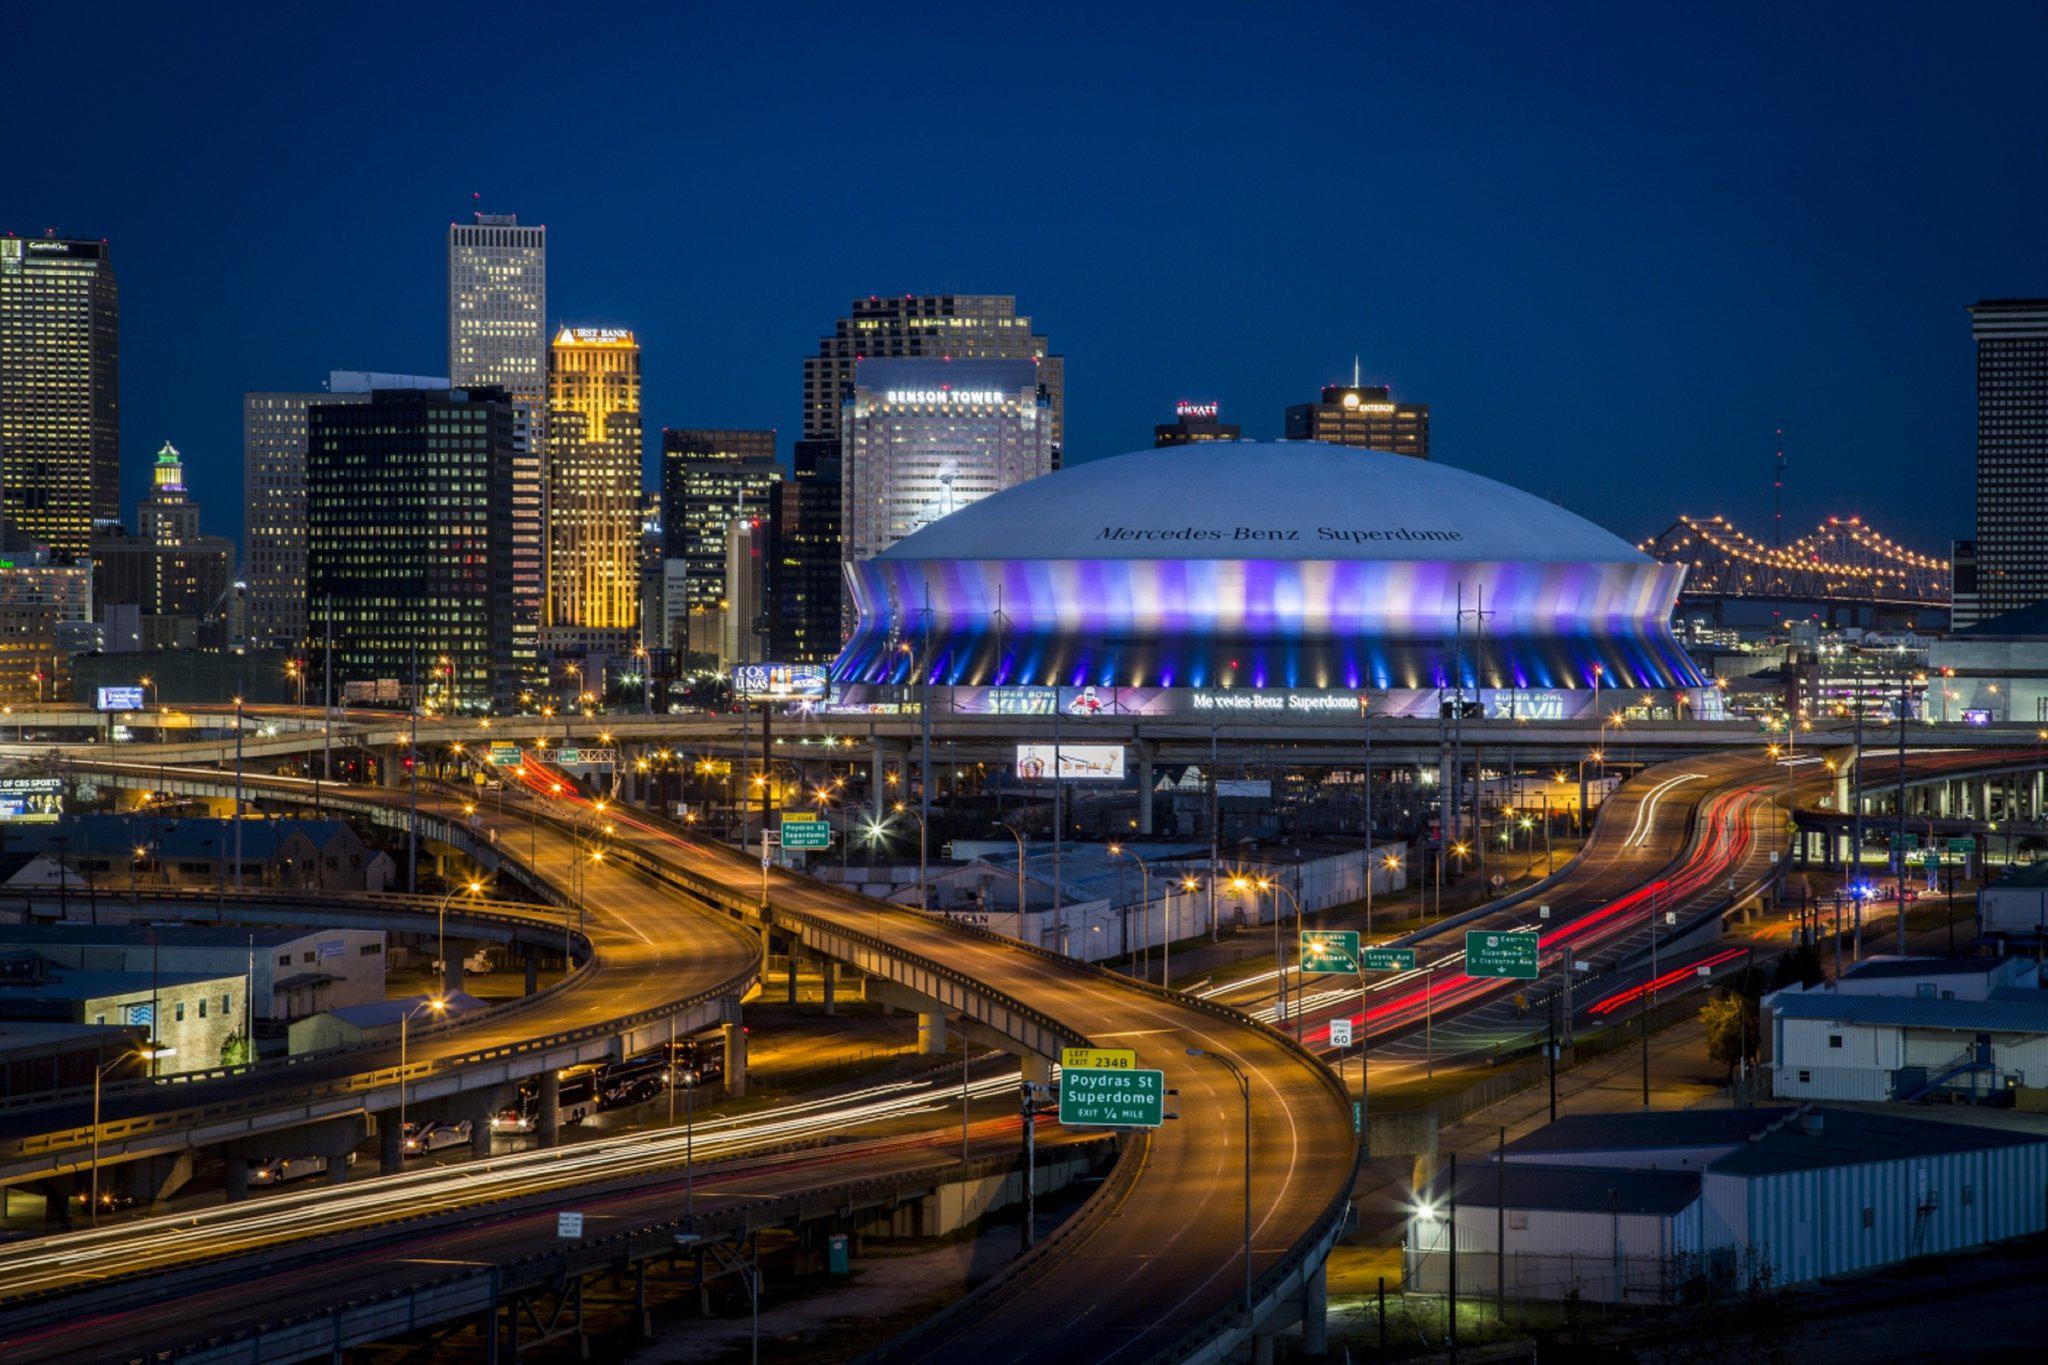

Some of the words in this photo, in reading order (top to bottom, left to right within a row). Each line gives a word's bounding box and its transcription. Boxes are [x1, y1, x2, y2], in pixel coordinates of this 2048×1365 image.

[600, 329, 628, 338] BANK
[887, 391, 948, 404] BENSON
[950, 391, 1004, 404] TOWER
[1096, 526, 1300, 542] Mercedes-Benz
[1317, 526, 1464, 543] Superdome
[1028, 690, 1057, 699] BOWL
[1534, 692, 1564, 702] BOWL
[1289, 694, 1359, 711] Superdome
[1494, 702, 1563, 719] XLVII
[14, 779, 30, 788] CBS
[31, 779, 61, 787] SPORTS
[785, 824, 815, 832] Poydras
[784, 832, 826, 840] Superdome
[1333, 1035, 1348, 1044] 60
[1069, 1058, 1088, 1066] EXIT
[1095, 1057, 1128, 1068] 234B
[1070, 1074, 1131, 1089] Poydras
[1138, 1076, 1153, 1088] St
[1068, 1090, 1155, 1105] Superdome
[1078, 1108, 1098, 1117] EXIT
[1121, 1110, 1144, 1119] MILE
